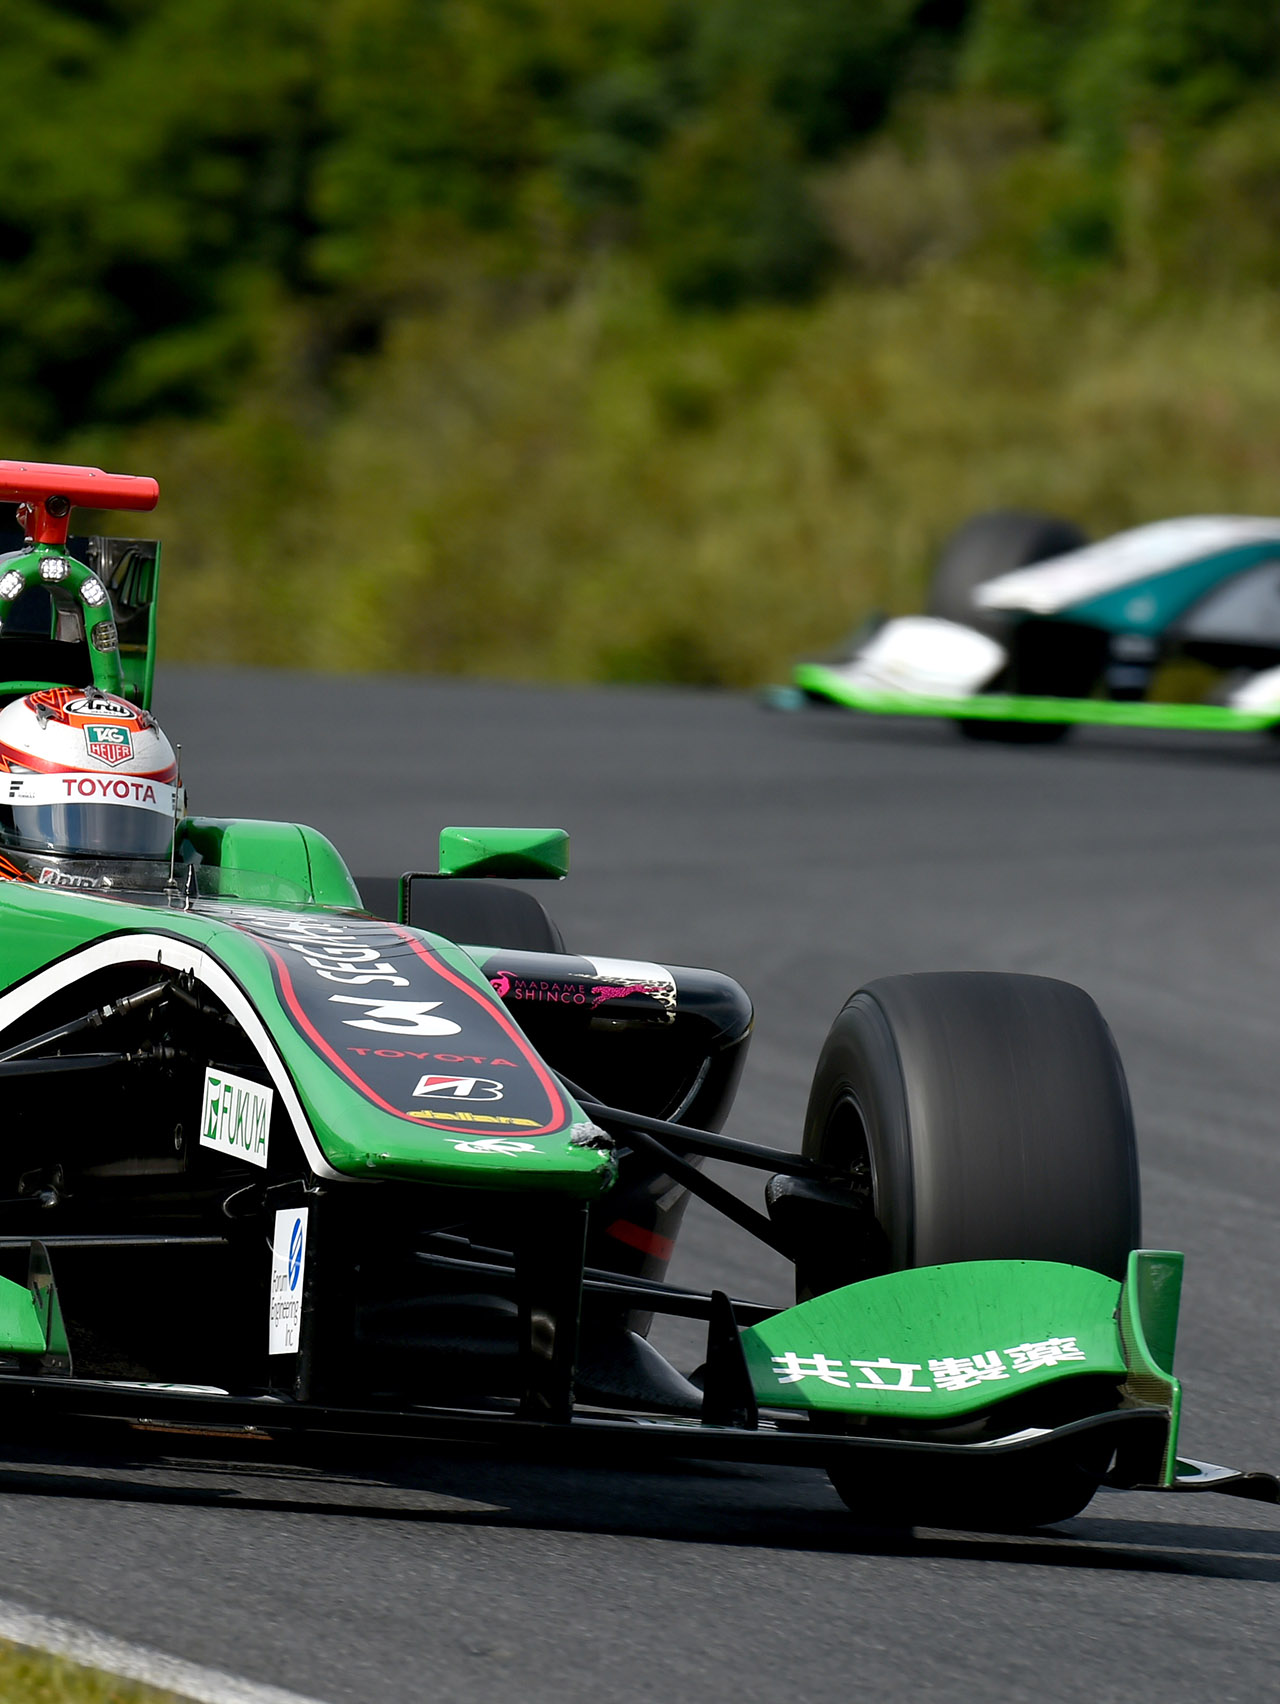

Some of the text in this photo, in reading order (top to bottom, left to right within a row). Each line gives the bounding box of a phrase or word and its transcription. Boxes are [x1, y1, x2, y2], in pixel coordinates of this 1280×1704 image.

[93, 728, 125, 743] TAG
[91, 744, 130, 761] HEUER
[62, 778, 157, 804] TOYOTA
[514, 979, 586, 994] MADAME
[514, 988, 586, 1005] SHINCO
[328, 994, 462, 1037] 3
[346, 1047, 519, 1068] TOYOTA
[219, 1084, 267, 1156] FUKUYA
[405, 1109, 544, 1128] dallara
[771, 1336, 1086, 1394] 共立製薬
